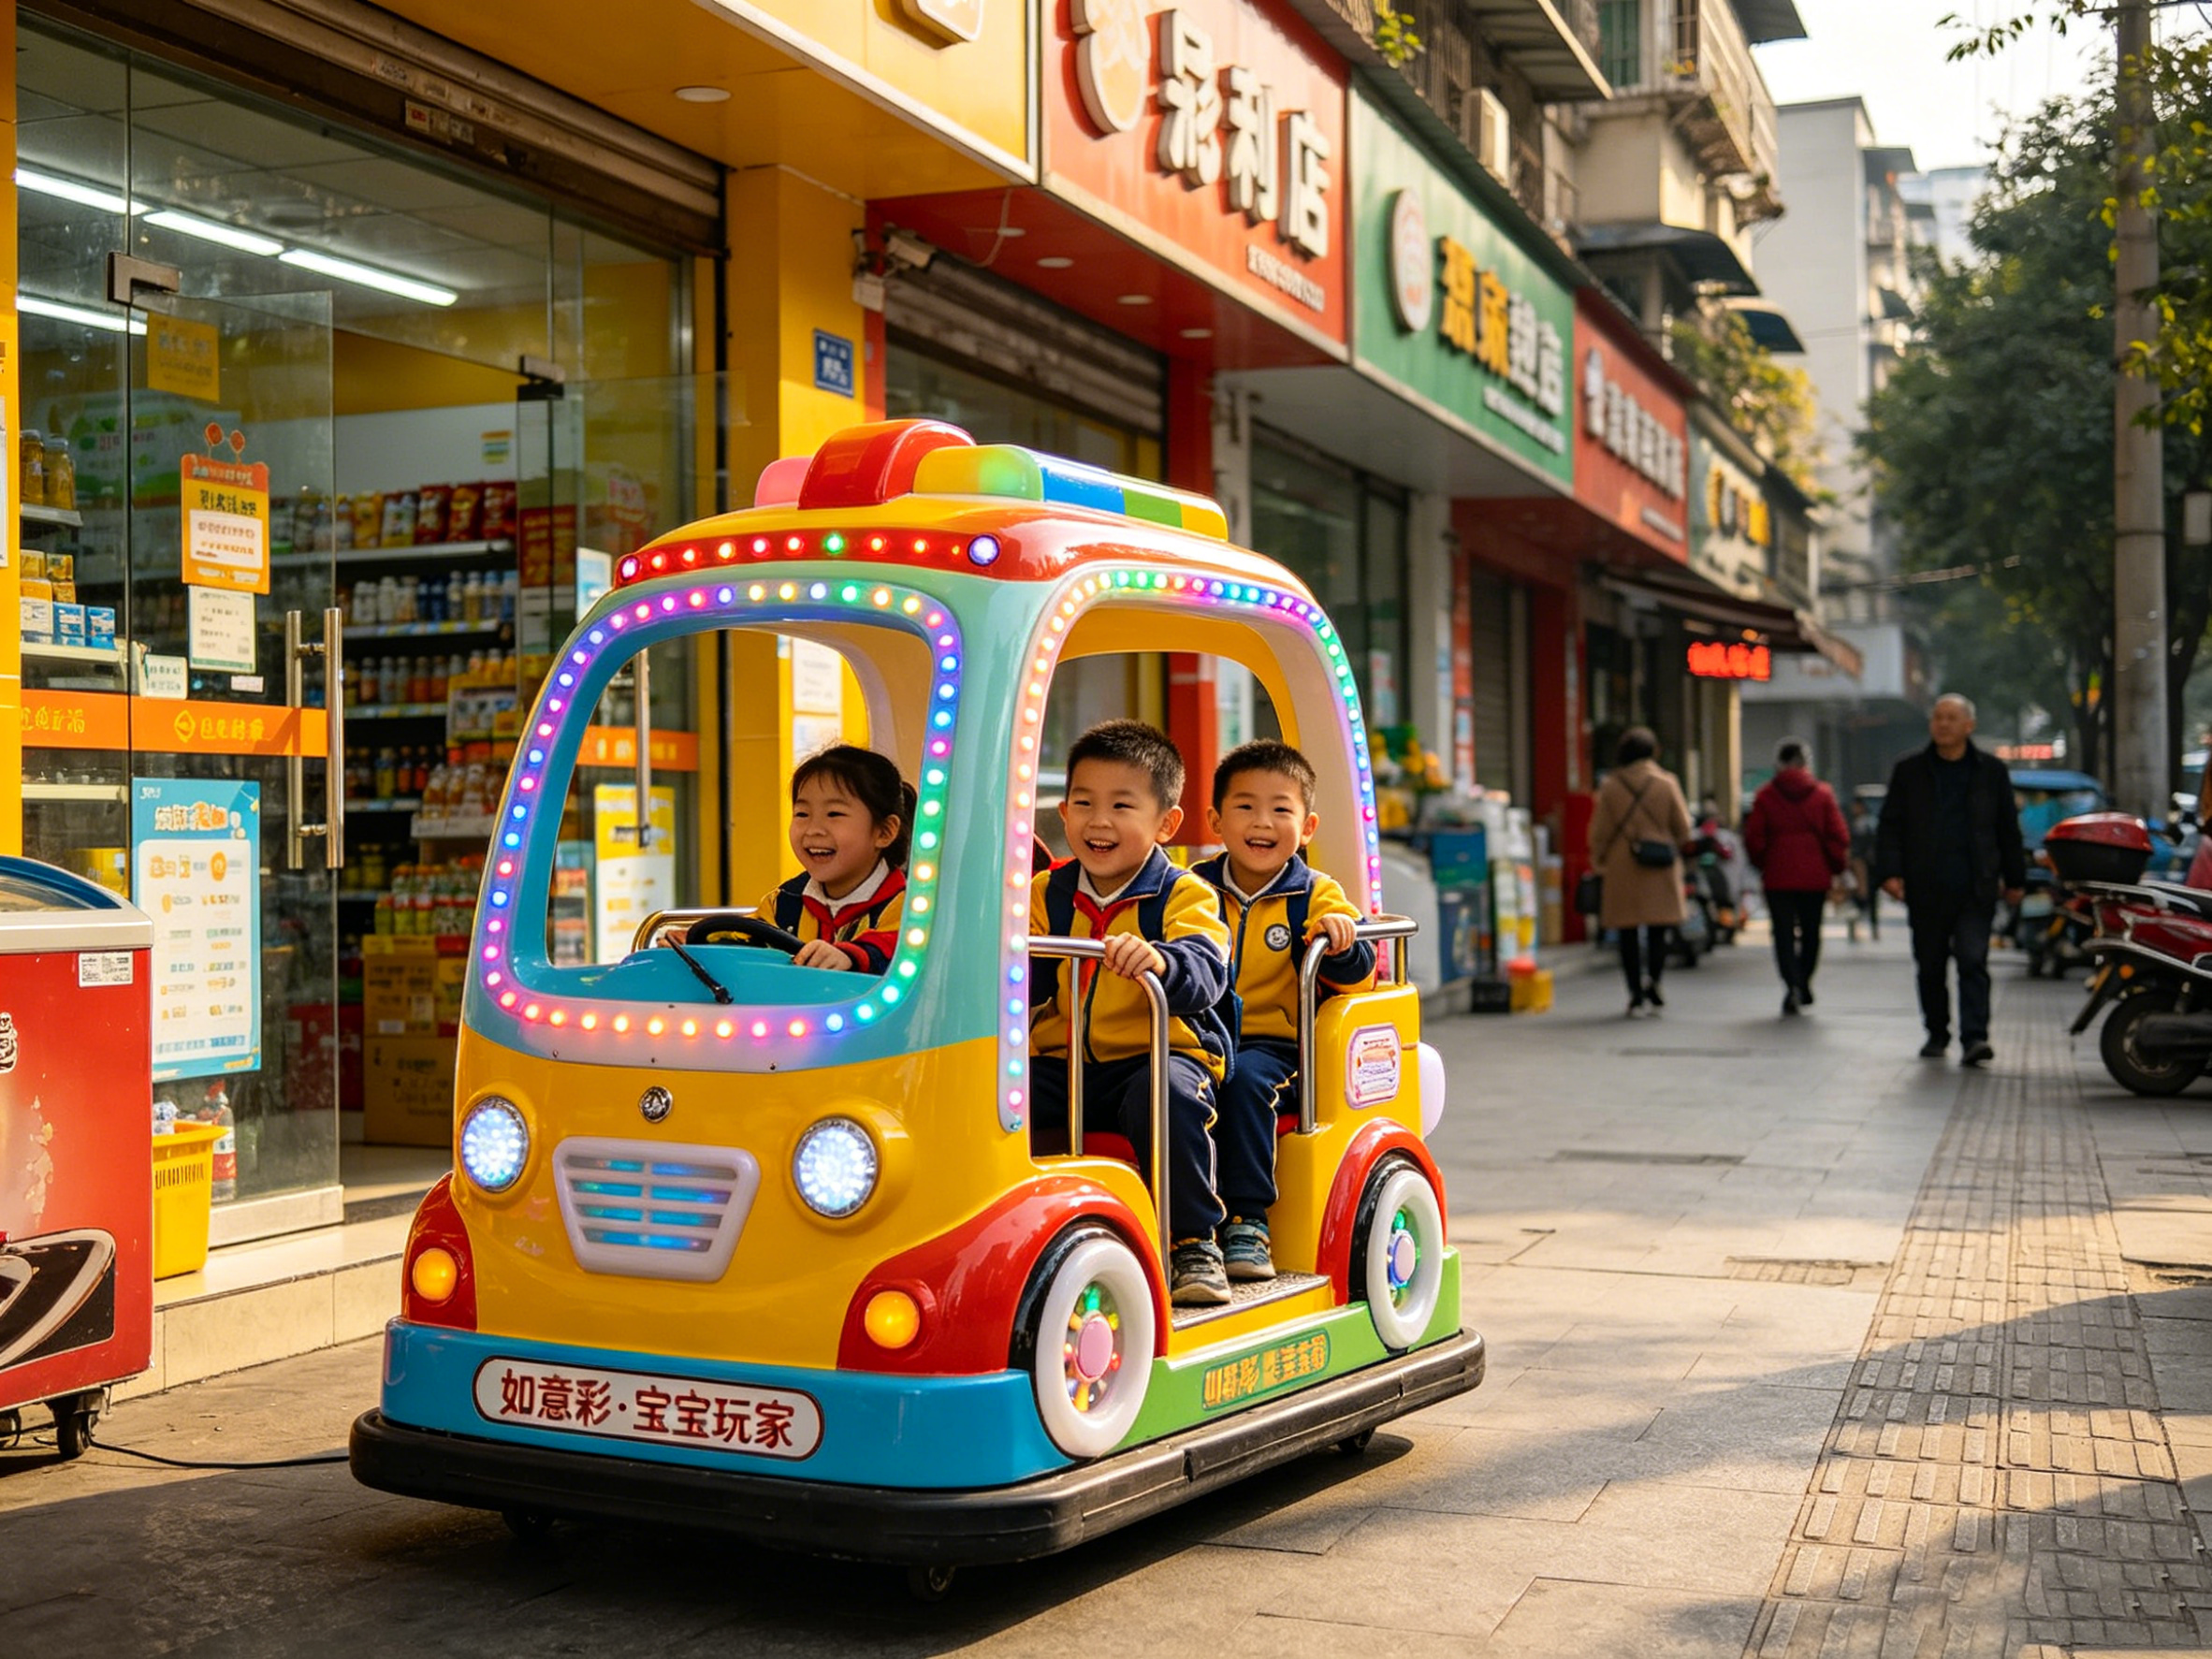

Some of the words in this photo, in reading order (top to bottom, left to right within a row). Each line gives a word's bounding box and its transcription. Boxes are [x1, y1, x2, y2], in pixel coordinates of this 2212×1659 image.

[500, 1368, 794, 1448] 如意彩·宝宝玩家
